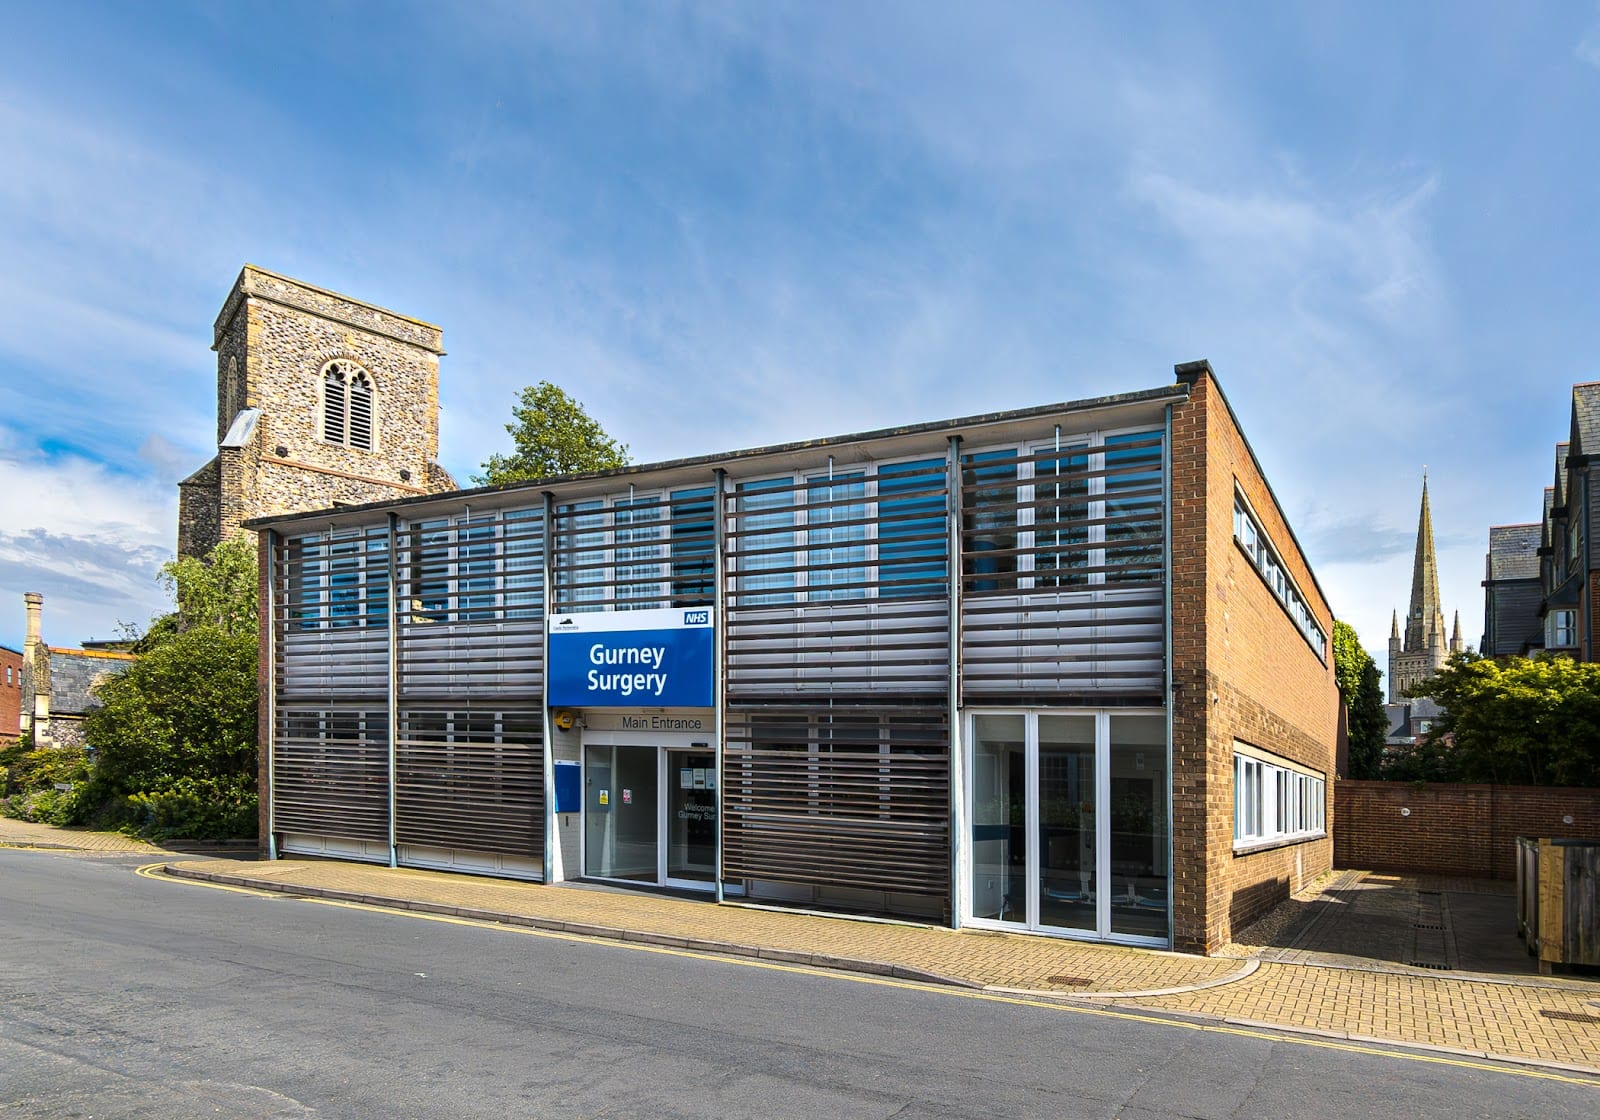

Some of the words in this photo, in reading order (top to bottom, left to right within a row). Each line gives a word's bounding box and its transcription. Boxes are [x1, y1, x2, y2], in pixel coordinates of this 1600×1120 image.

[686, 612, 707, 623] NHS
[590, 644, 665, 669] Gurney
[587, 669, 667, 696] Surgery
[622, 716, 648, 729] Main
[651, 716, 701, 729] Entrance
[684, 802, 715, 813] Welcome
[678, 810, 703, 821] Gurney
[703, 811, 716, 821] Sur
